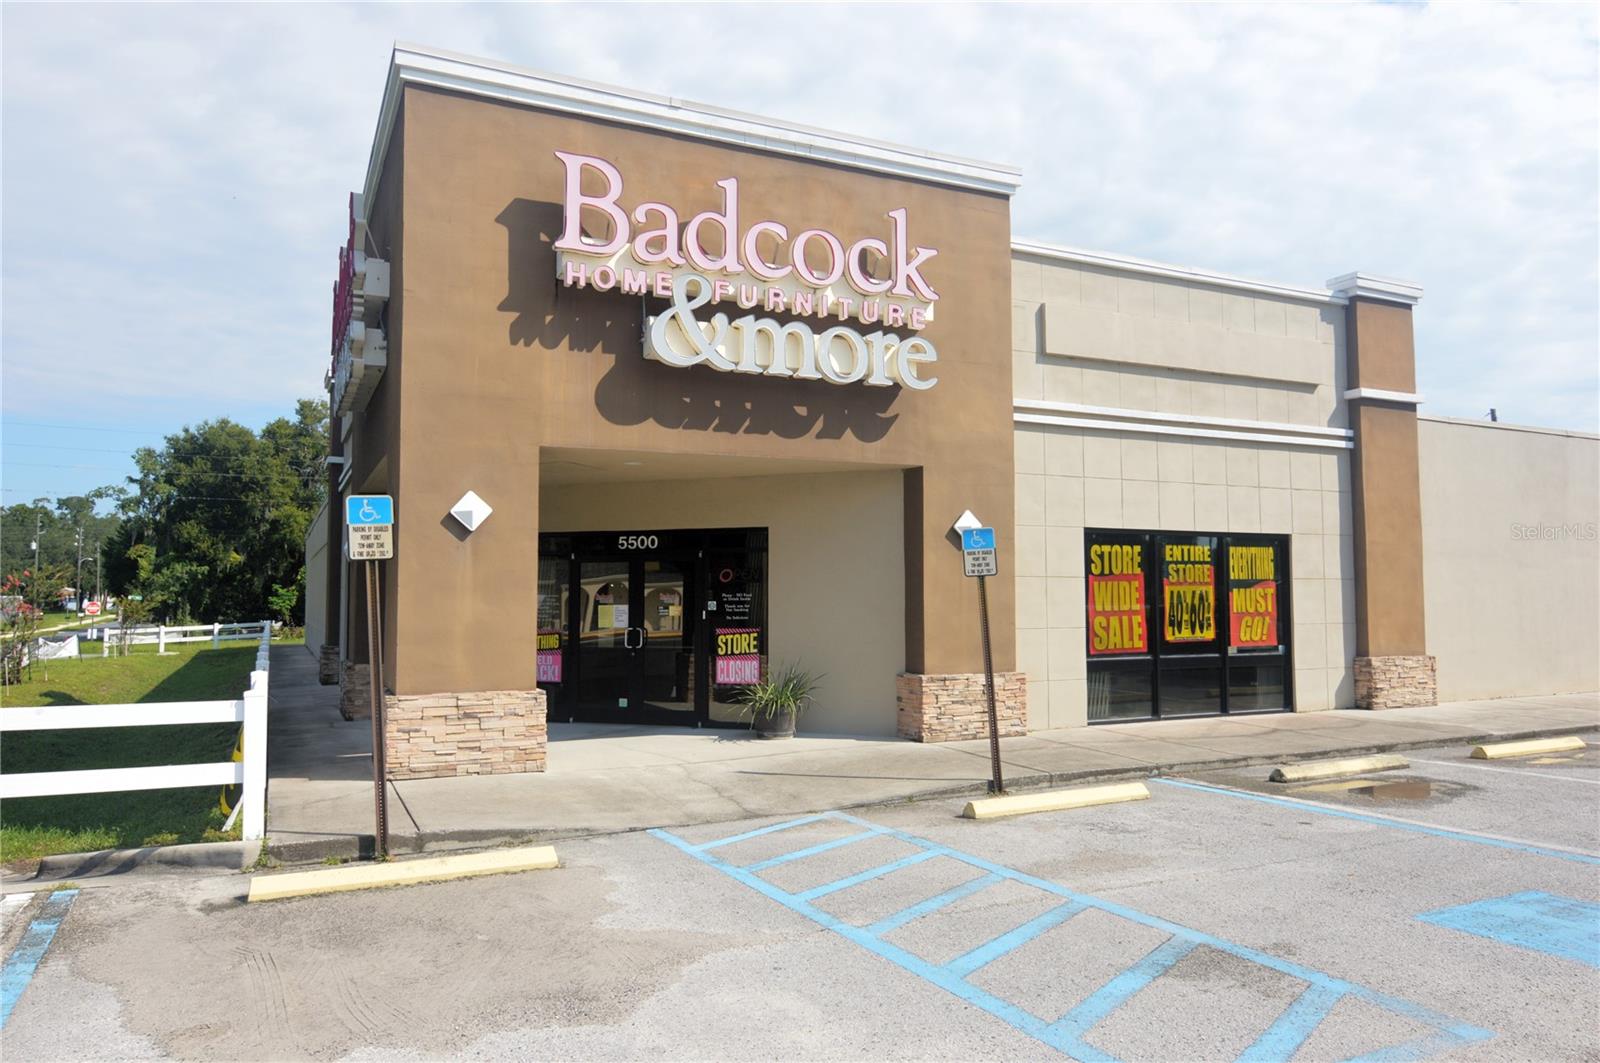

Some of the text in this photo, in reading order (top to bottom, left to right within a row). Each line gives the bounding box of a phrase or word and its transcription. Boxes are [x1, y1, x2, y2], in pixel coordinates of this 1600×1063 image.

[553, 151, 940, 301] Badcock
[564, 261, 929, 331] HOME FURNITURE
[618, 535, 659, 549] 5500
[1165, 544, 1211, 562] ENTIRE
[1090, 544, 1142, 575] STORE
[1229, 546, 1274, 580] EVERYTHING
[1168, 564, 1211, 583] STORE
[1094, 580, 1140, 612] WIDE
[1232, 588, 1274, 613] MUST
[1094, 615, 1143, 650] SALE
[1240, 615, 1270, 642] GO!
[537, 634, 560, 650] THING
[717, 632, 758, 656] STORE
[537, 655, 553, 665] ELD
[719, 660, 758, 683] CLOSING
[537, 665, 560, 682] CK!
